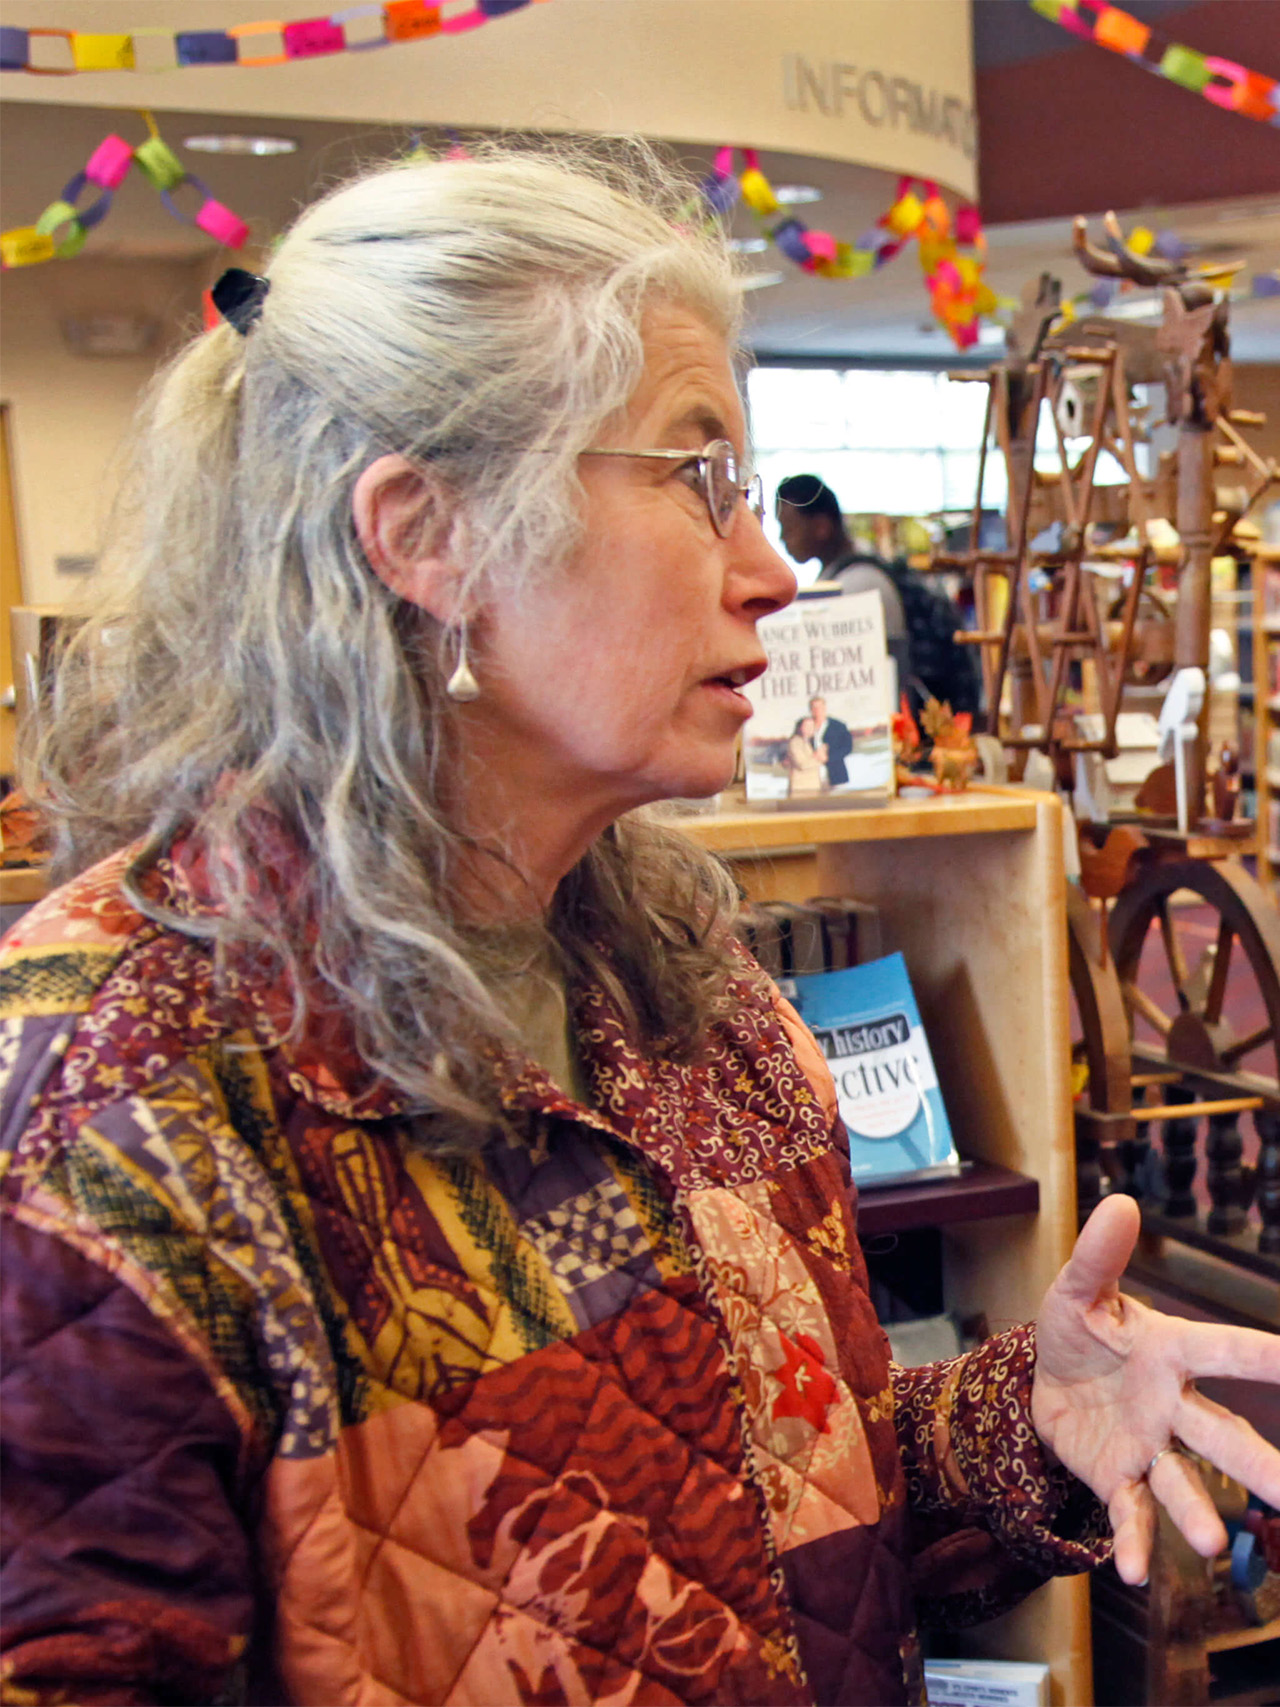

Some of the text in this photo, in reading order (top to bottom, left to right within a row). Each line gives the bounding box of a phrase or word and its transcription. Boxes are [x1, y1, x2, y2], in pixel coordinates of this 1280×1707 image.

[810, 645, 863, 671] FROM
[760, 666, 876, 699] THE DREAM
[831, 1018, 904, 1057] history
